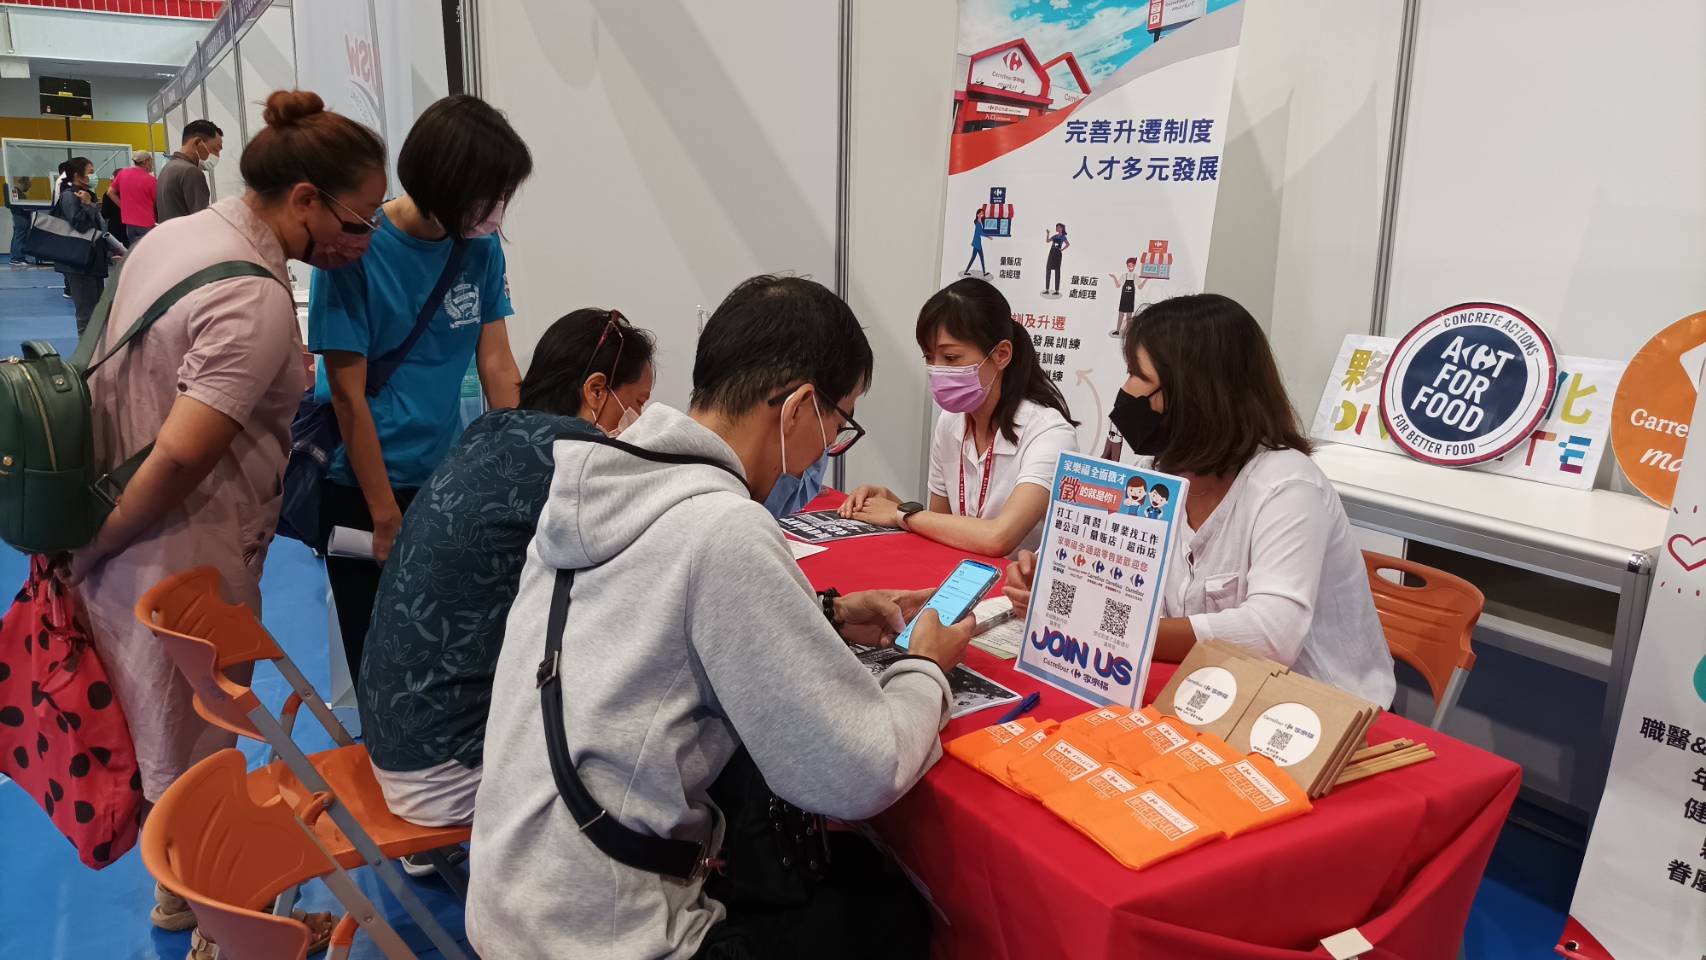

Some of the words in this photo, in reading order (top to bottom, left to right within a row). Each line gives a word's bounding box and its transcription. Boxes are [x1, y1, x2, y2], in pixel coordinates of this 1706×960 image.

[1064, 118, 1214, 144] 完善升遷制度
[1072, 155, 1219, 181] 人才多元發展
[999, 269, 1021, 279] 店經理
[1000, 256, 1022, 266] 量販店
[1071, 275, 1099, 286] 量販店
[1033, 334, 1081, 350] 發展訓練
[1444, 311, 1503, 328] CONCRETE
[1503, 319, 1539, 357] ACTIONS
[1432, 362, 1490, 404] FOR
[1410, 385, 1485, 433] FOOD
[1392, 413, 1410, 433] FOR
[1406, 431, 1442, 454] BETTER
[1445, 443, 1476, 456] FOOD
[1631, 408, 1690, 438] Carre
[1031, 625, 1090, 669] JOIN
[1093, 647, 1133, 686] US
[1043, 657, 1070, 673] Carrefour
